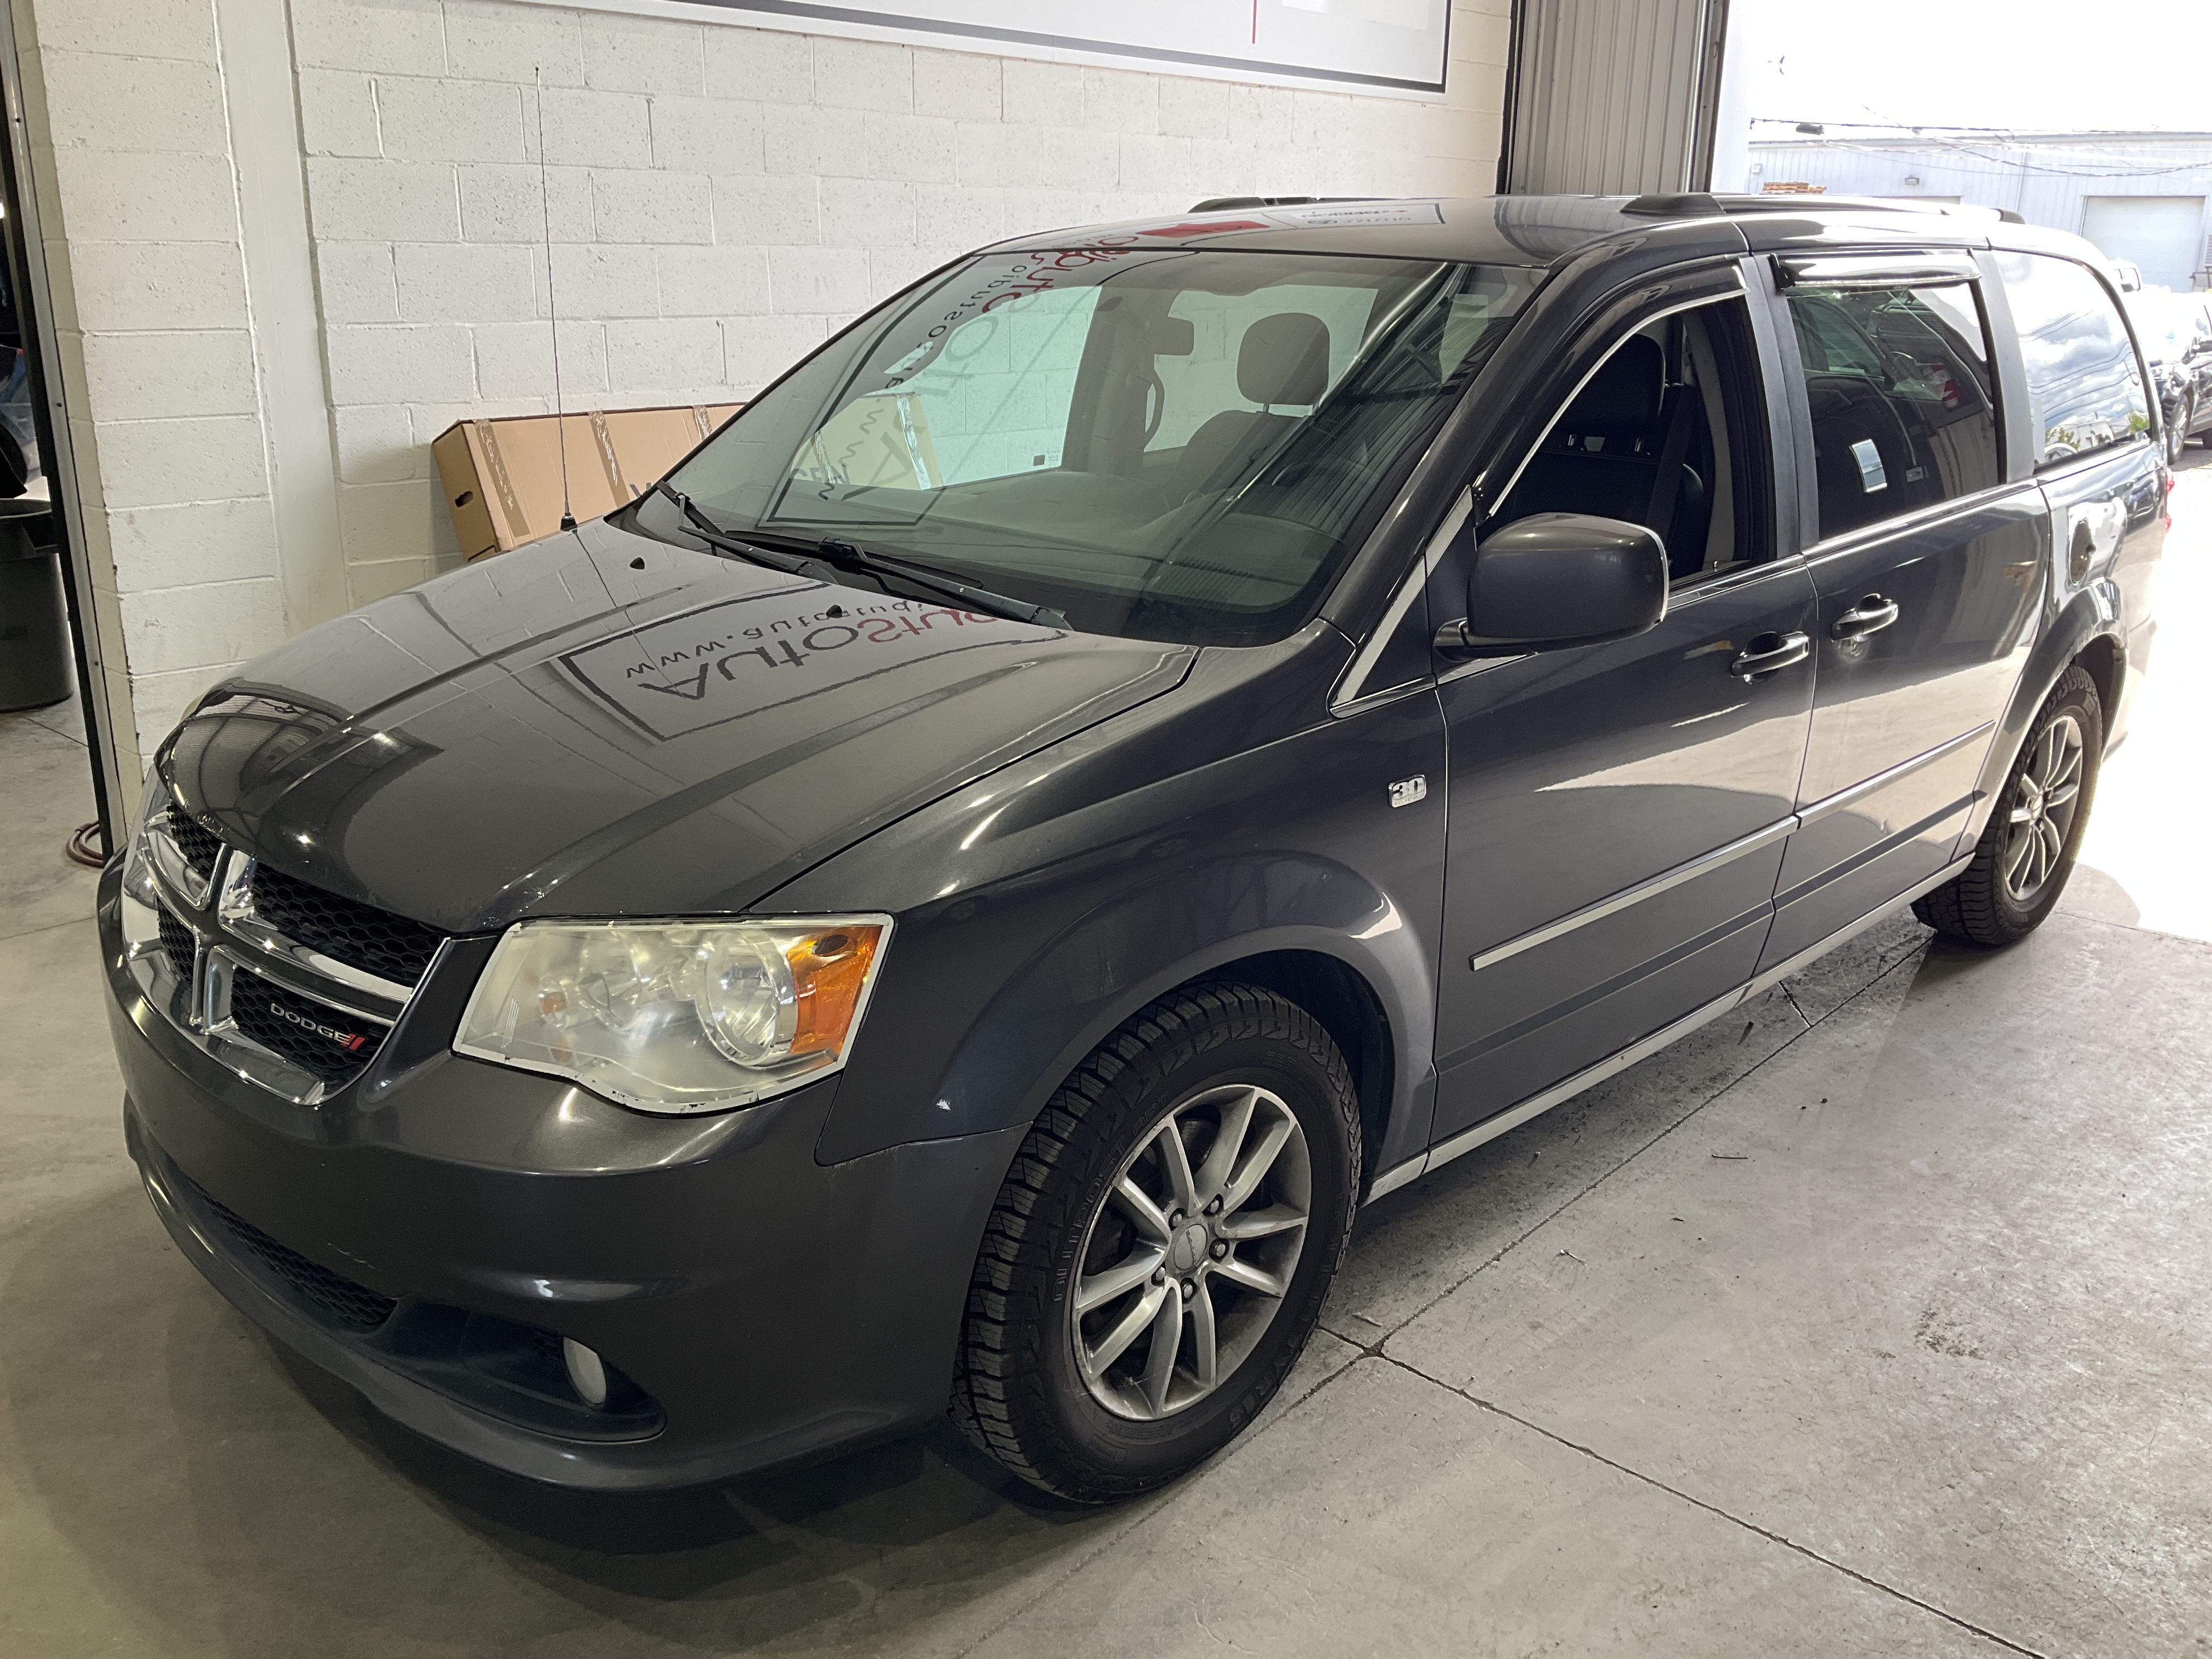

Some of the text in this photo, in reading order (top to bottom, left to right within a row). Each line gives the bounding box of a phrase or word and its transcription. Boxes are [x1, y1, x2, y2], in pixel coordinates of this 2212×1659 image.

[1393, 777, 1424, 800] 30
[270, 1003, 351, 1045] DODGE
[1052, 1092, 1170, 1302] OUTPOST APT
